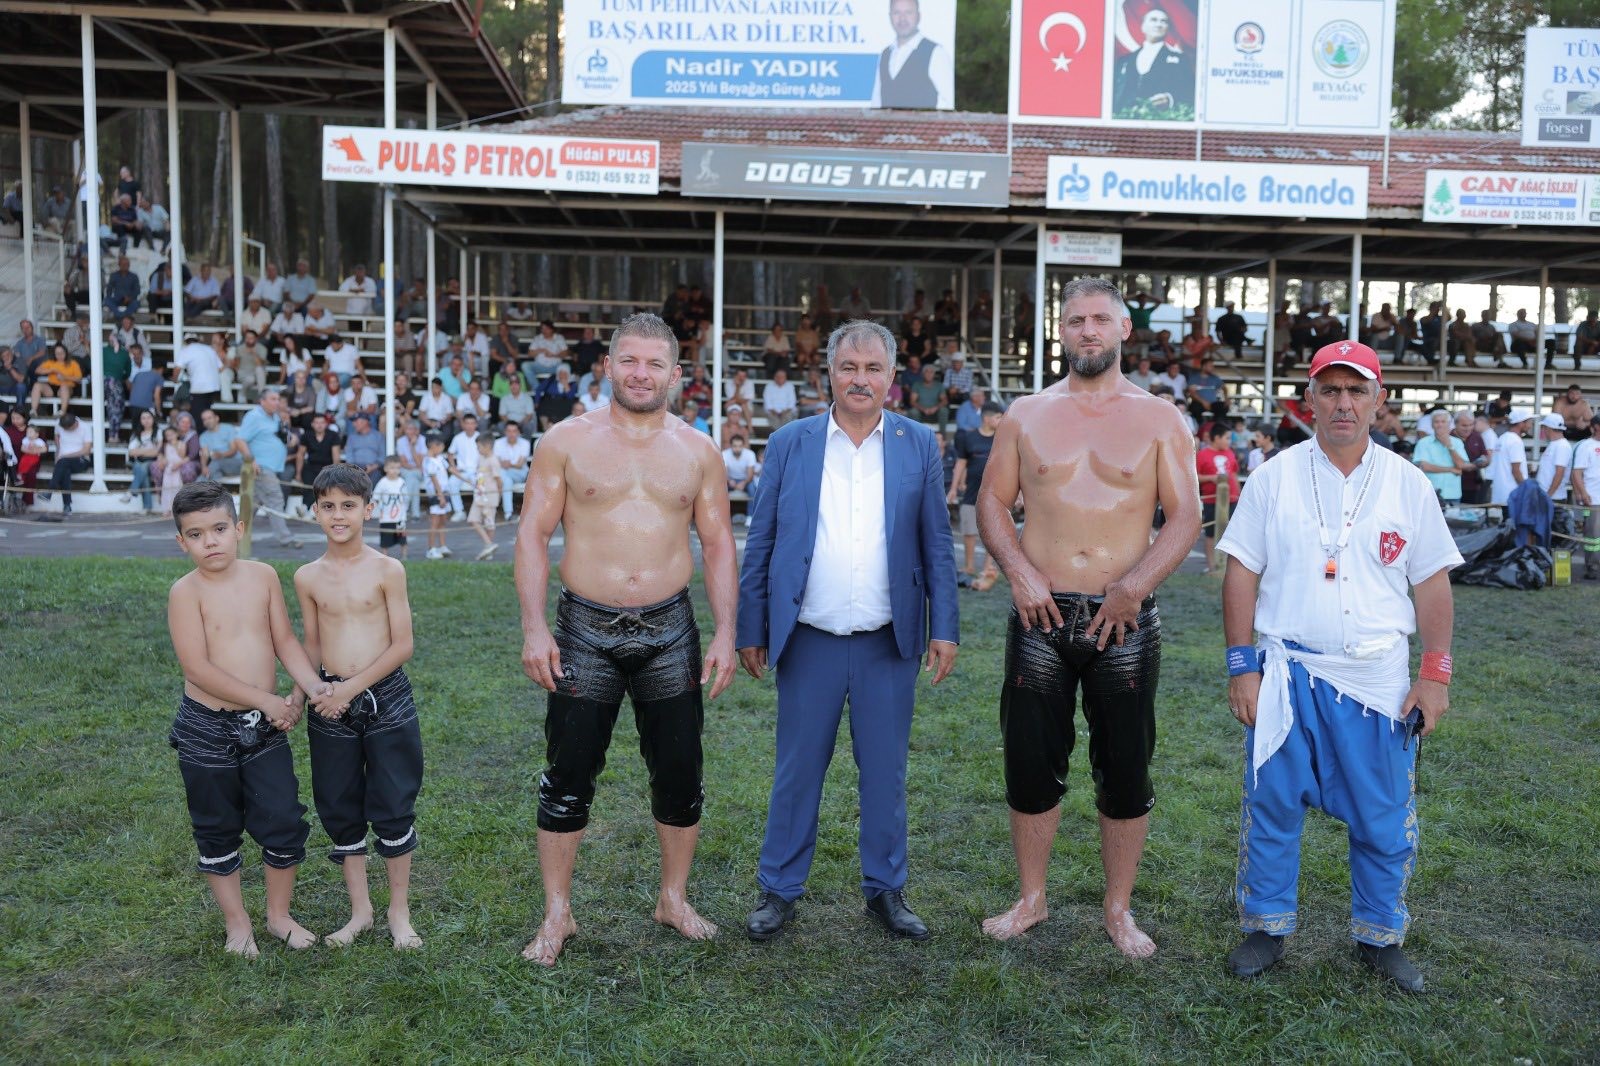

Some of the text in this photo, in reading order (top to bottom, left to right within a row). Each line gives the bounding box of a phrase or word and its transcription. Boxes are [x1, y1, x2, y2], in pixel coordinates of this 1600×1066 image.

[588, 19, 865, 44] BAŞARILAR DİLERİM.
[665, 57, 840, 78] Nadir YADIK
[664, 80, 841, 98] 2025 Yılı Beyağaç Güreş Ağası
[1312, 80, 1367, 96] BEYAĞAÇ
[1545, 121, 1584, 135] forset
[378, 139, 557, 178] PULAŞ PETROL
[607, 148, 650, 167] PULAŞ
[566, 170, 651, 184] 0 (532) 455 92 22
[860, 163, 987, 190] TİCARET
[1461, 176, 1578, 195] CAN AĞAÇ İŞLERİ
[1102, 170, 1355, 206] Pamukkale Branda
[1490, 209, 1511, 219] CAN
